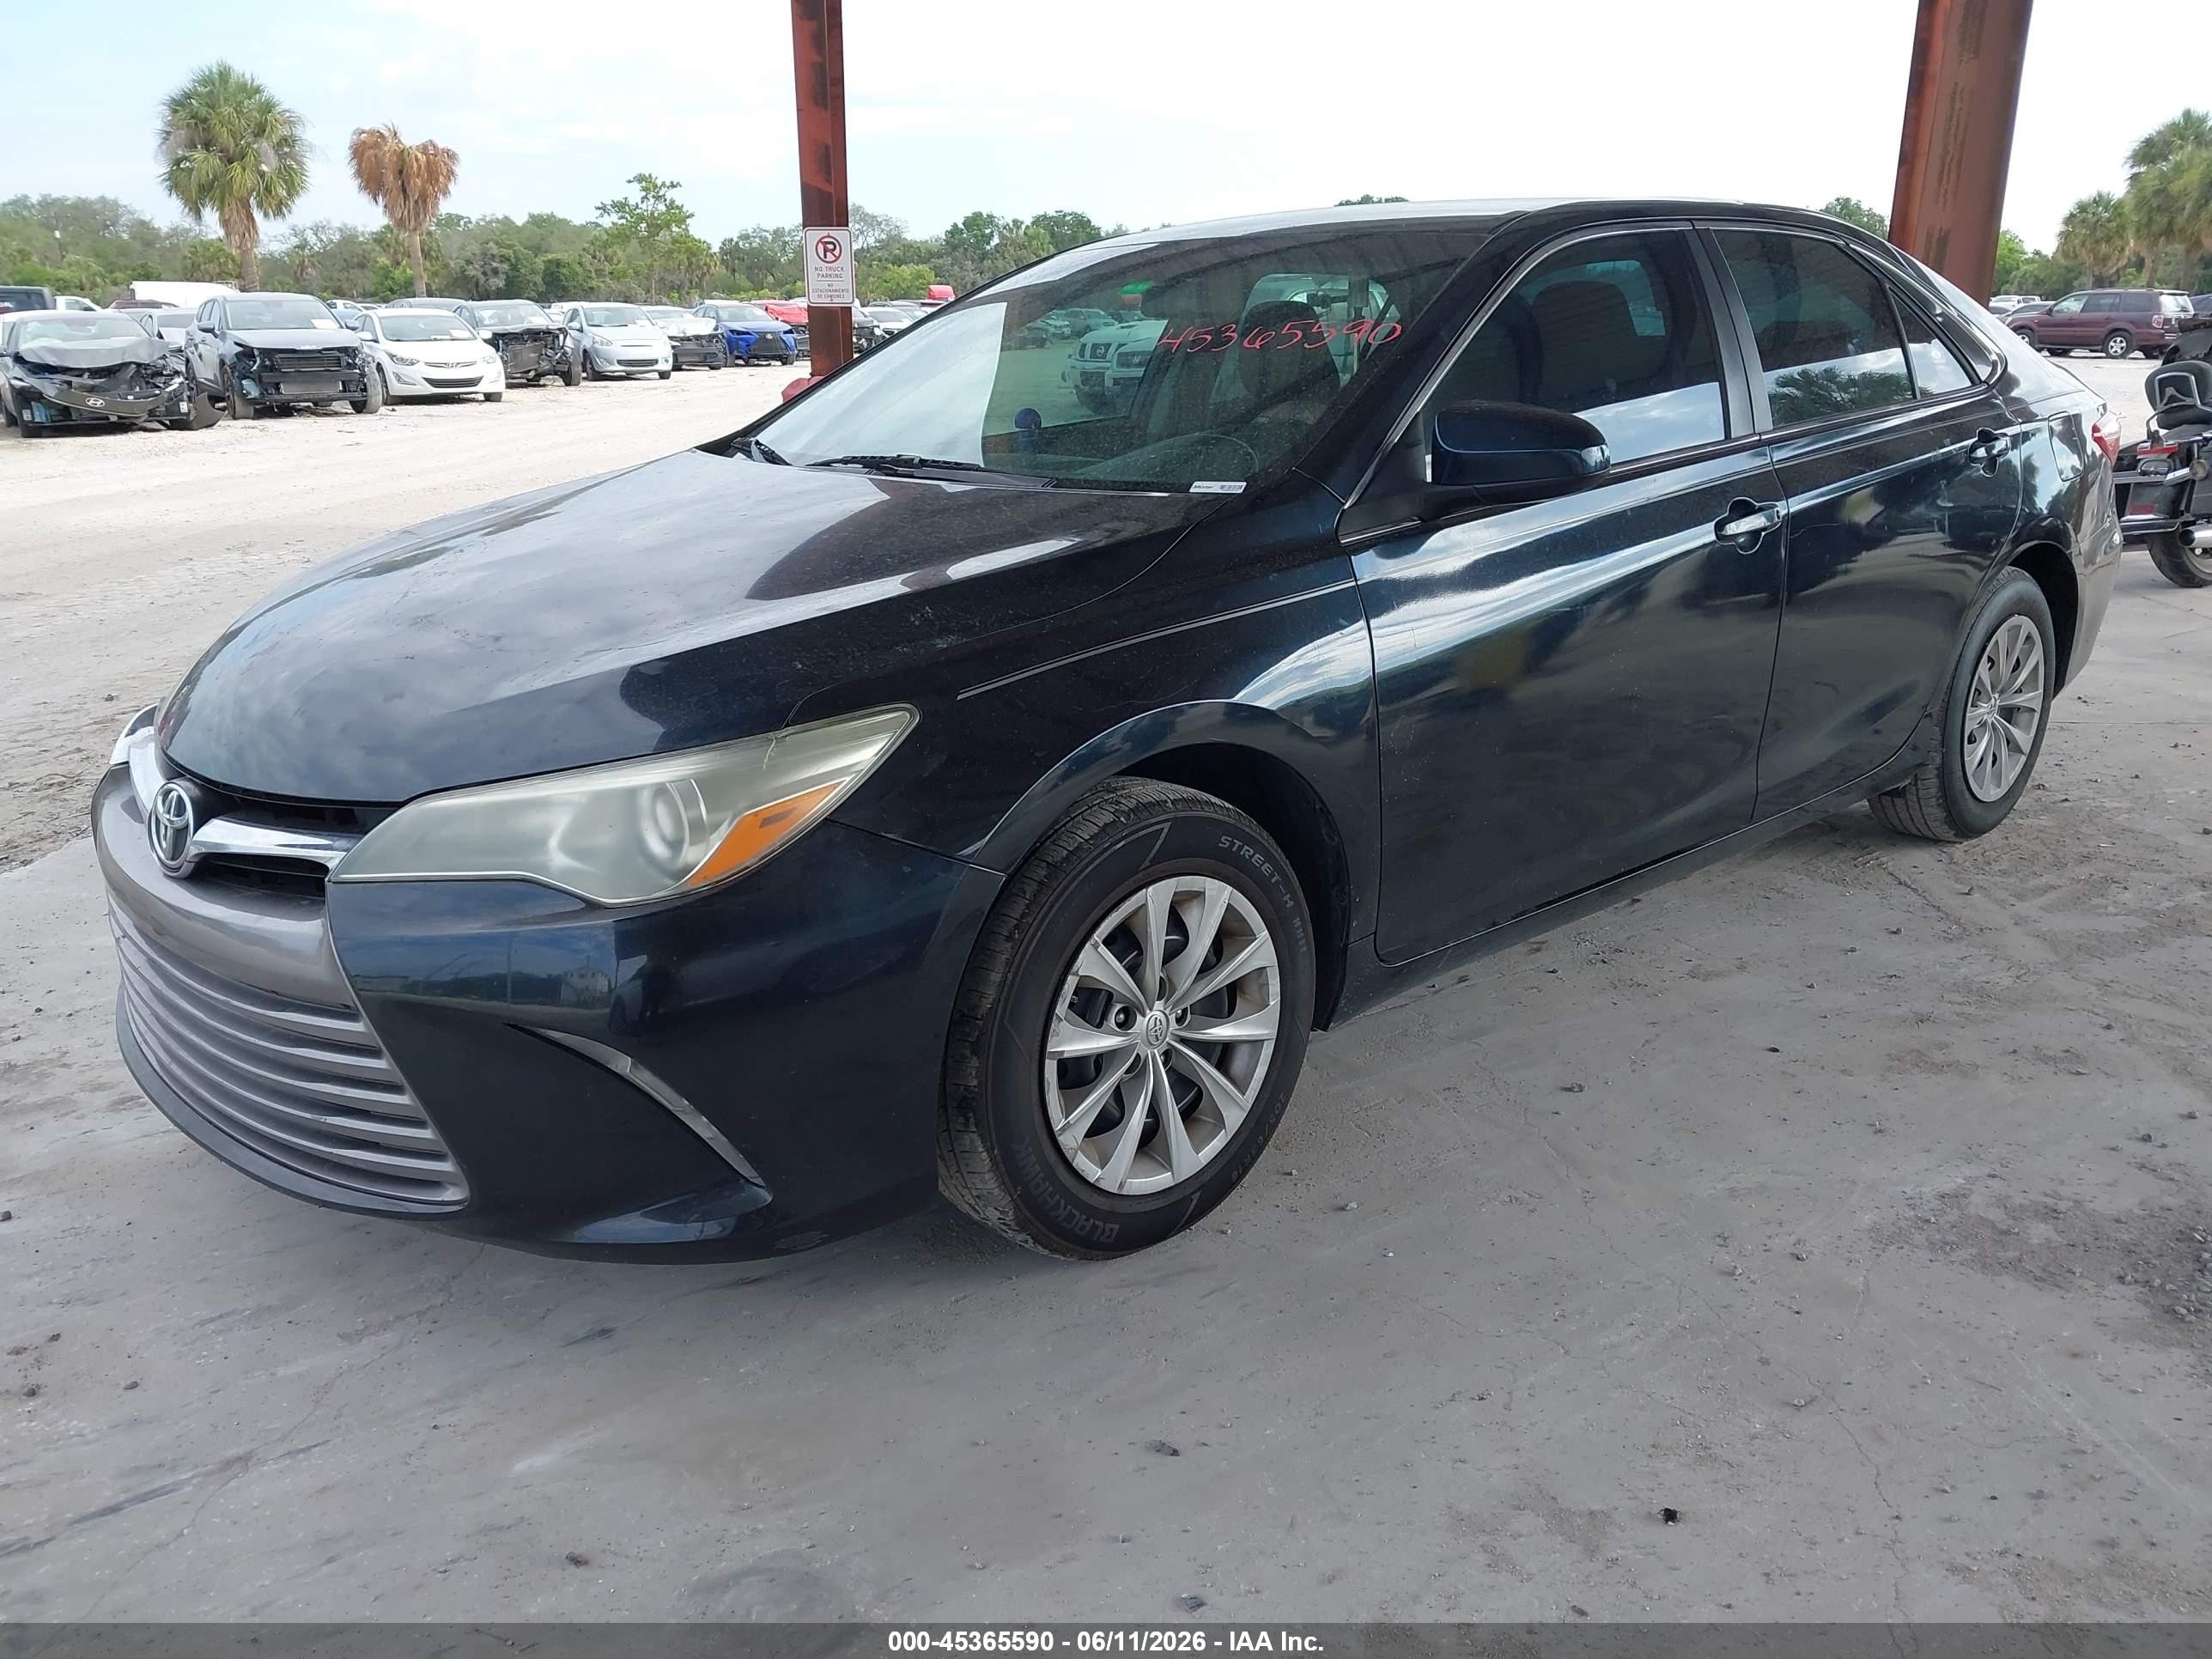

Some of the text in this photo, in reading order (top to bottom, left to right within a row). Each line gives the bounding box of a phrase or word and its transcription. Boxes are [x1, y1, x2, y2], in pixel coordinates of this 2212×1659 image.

[1157, 319, 1402, 354] 45365590
[1218, 835, 1295, 908] STREET-H
[1011, 1133, 1120, 1243] BLACKHAWK
